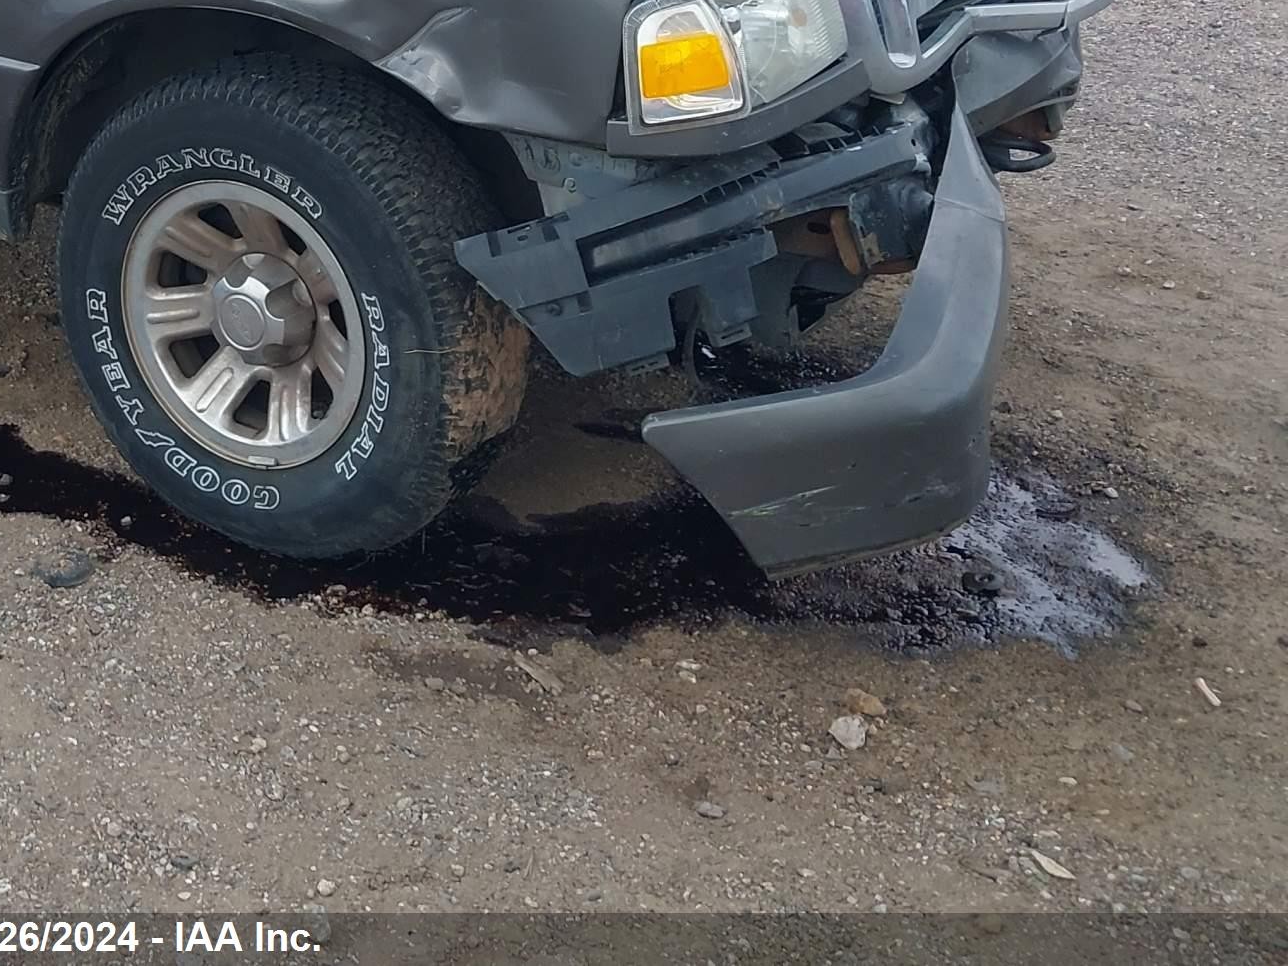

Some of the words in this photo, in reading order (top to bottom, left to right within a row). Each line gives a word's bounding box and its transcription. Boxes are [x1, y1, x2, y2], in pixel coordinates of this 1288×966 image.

[101, 146, 323, 225] WRANGLER
[86, 288, 281, 510] GOODYEAR
[335, 292, 391, 481] RADIAL
